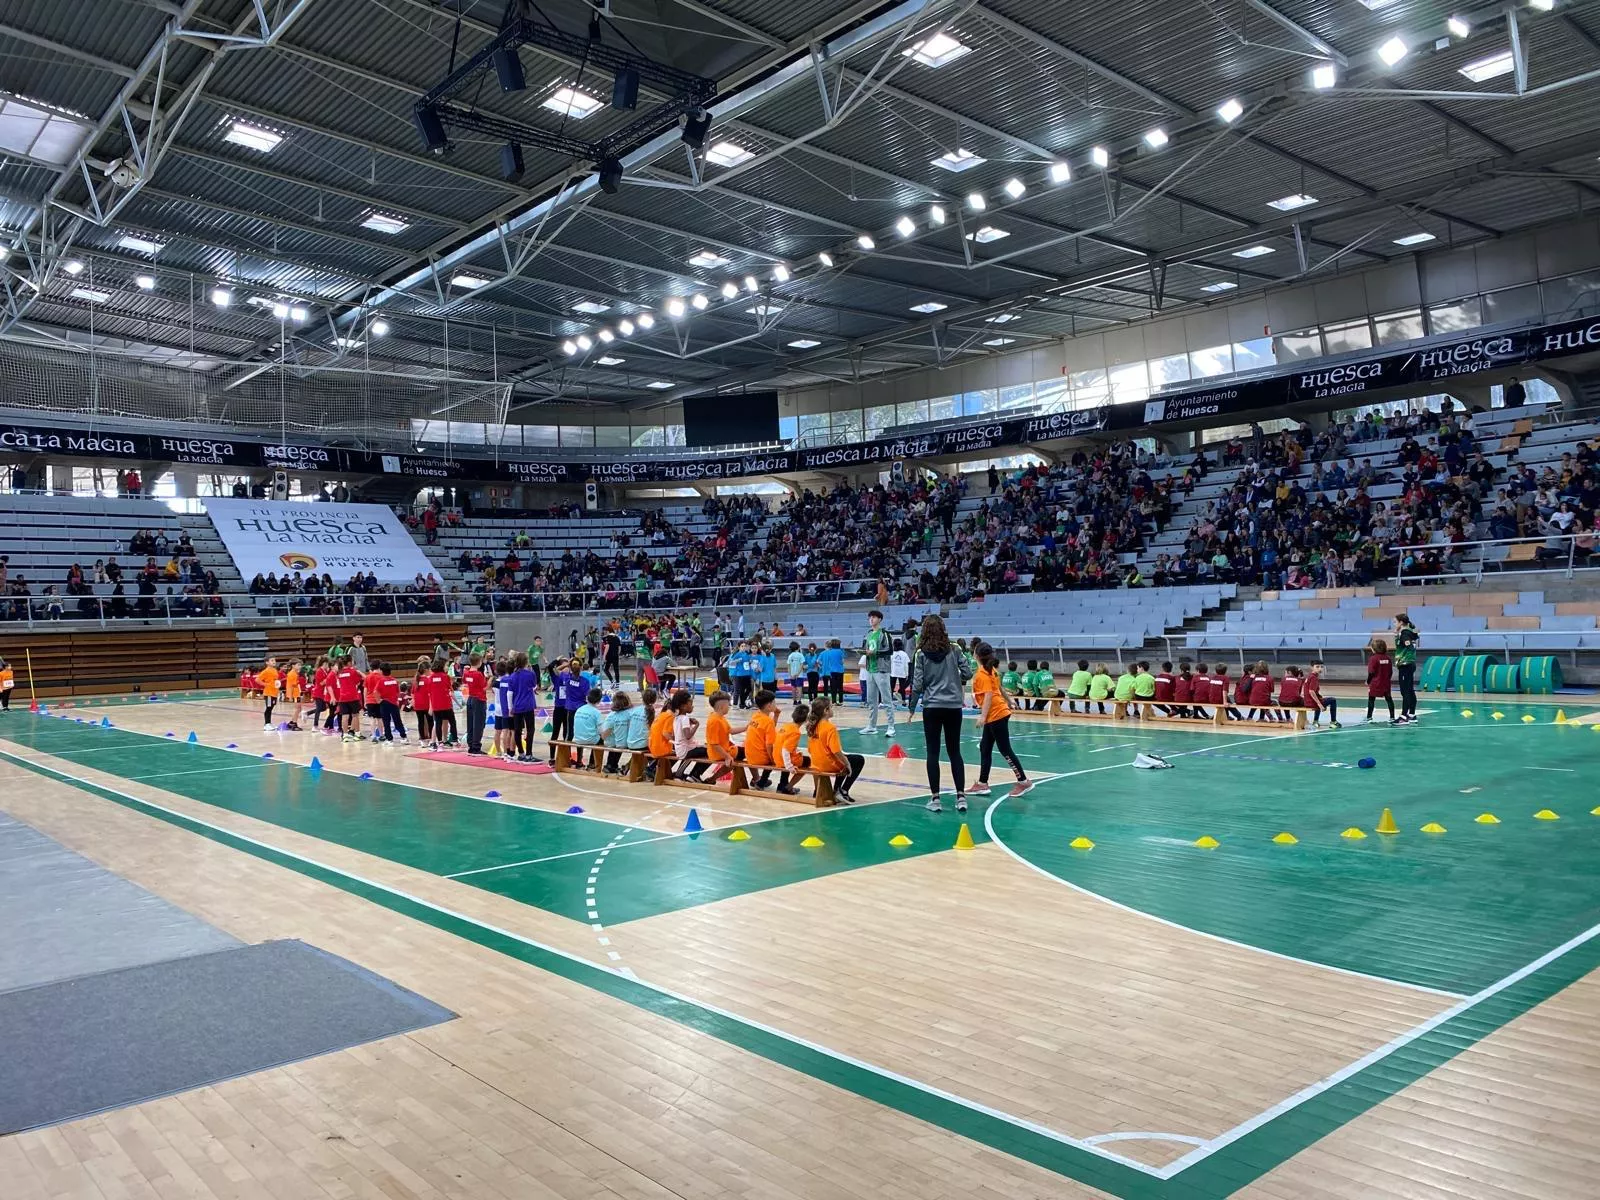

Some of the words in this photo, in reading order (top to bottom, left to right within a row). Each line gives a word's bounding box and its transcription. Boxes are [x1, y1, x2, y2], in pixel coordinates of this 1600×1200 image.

[1420, 338, 1513, 368] Huesca
[1300, 361, 1383, 389] Huesca
[1433, 367, 1448, 378] La
[1168, 389, 1238, 409] Ayuntamiento
[1314, 388, 1328, 398] La
[1166, 410, 1179, 420] de
[1180, 404, 1219, 419] Huesca
[1027, 411, 1090, 432] Huesca
[945, 425, 1003, 443] Huesca
[161, 438, 236, 456] Huesca
[402, 457, 461, 469] Ayuntamiento
[805, 448, 860, 467] Huesca
[403, 467, 415, 475] de
[416, 467, 448, 477] Huesca
[508, 463, 567, 475] Huesca
[591, 462, 648, 475] Huesca
[664, 462, 723, 477] Huesca
[233, 517, 391, 536] Huesca
